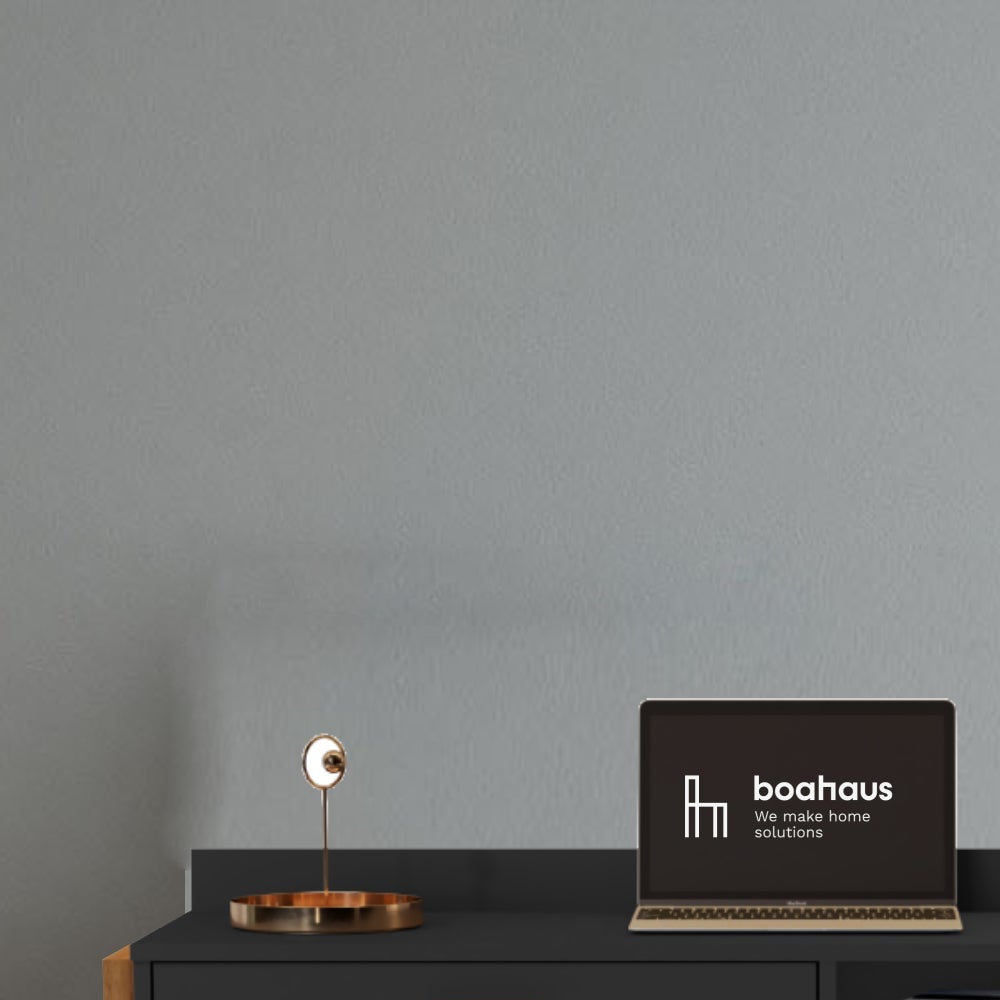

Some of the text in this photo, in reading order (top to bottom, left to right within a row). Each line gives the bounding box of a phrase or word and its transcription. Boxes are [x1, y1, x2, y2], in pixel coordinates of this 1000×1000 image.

[754, 775, 893, 801] boahaus
[755, 810, 871, 822] We make home
[754, 826, 823, 838] solutions
